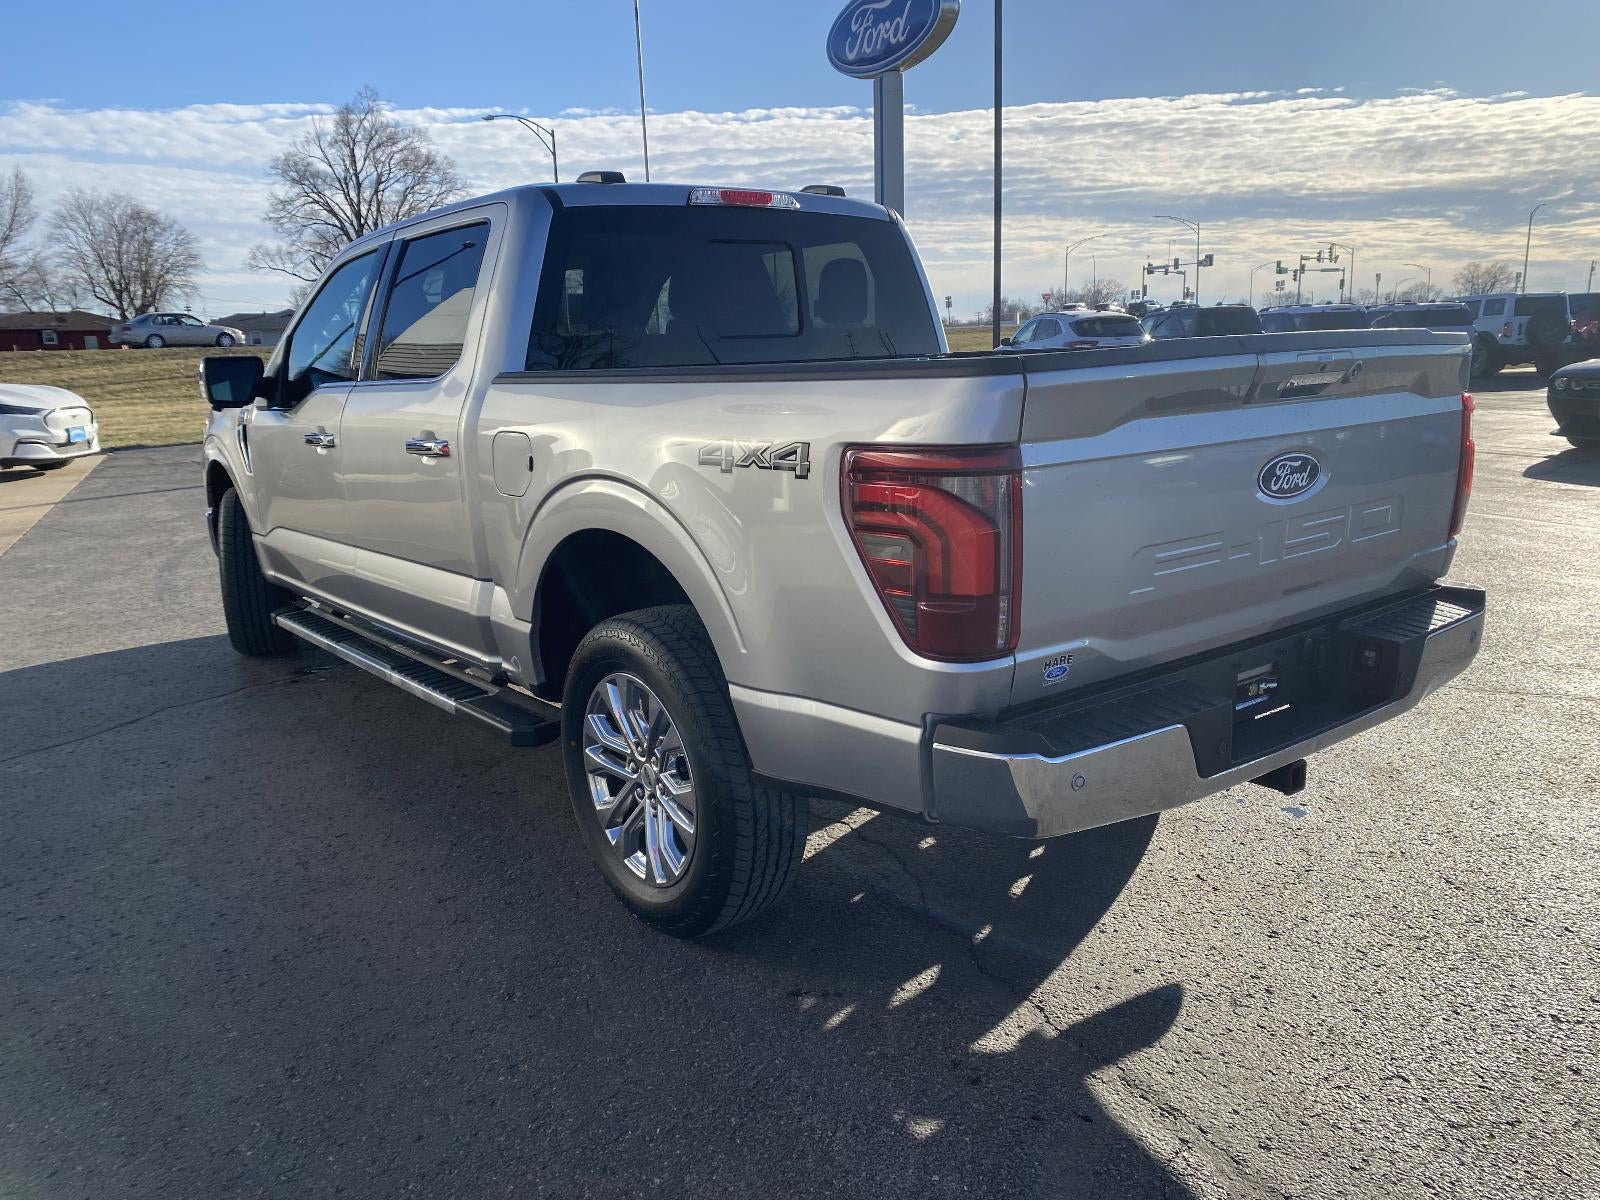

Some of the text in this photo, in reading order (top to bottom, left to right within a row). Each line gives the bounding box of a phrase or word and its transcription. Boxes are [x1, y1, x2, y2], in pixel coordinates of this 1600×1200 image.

[846, 0, 911, 60] Ford
[1271, 460, 1311, 491] Ford
[1129, 496, 1404, 596] F-150
[1043, 654, 1073, 671] HARE
